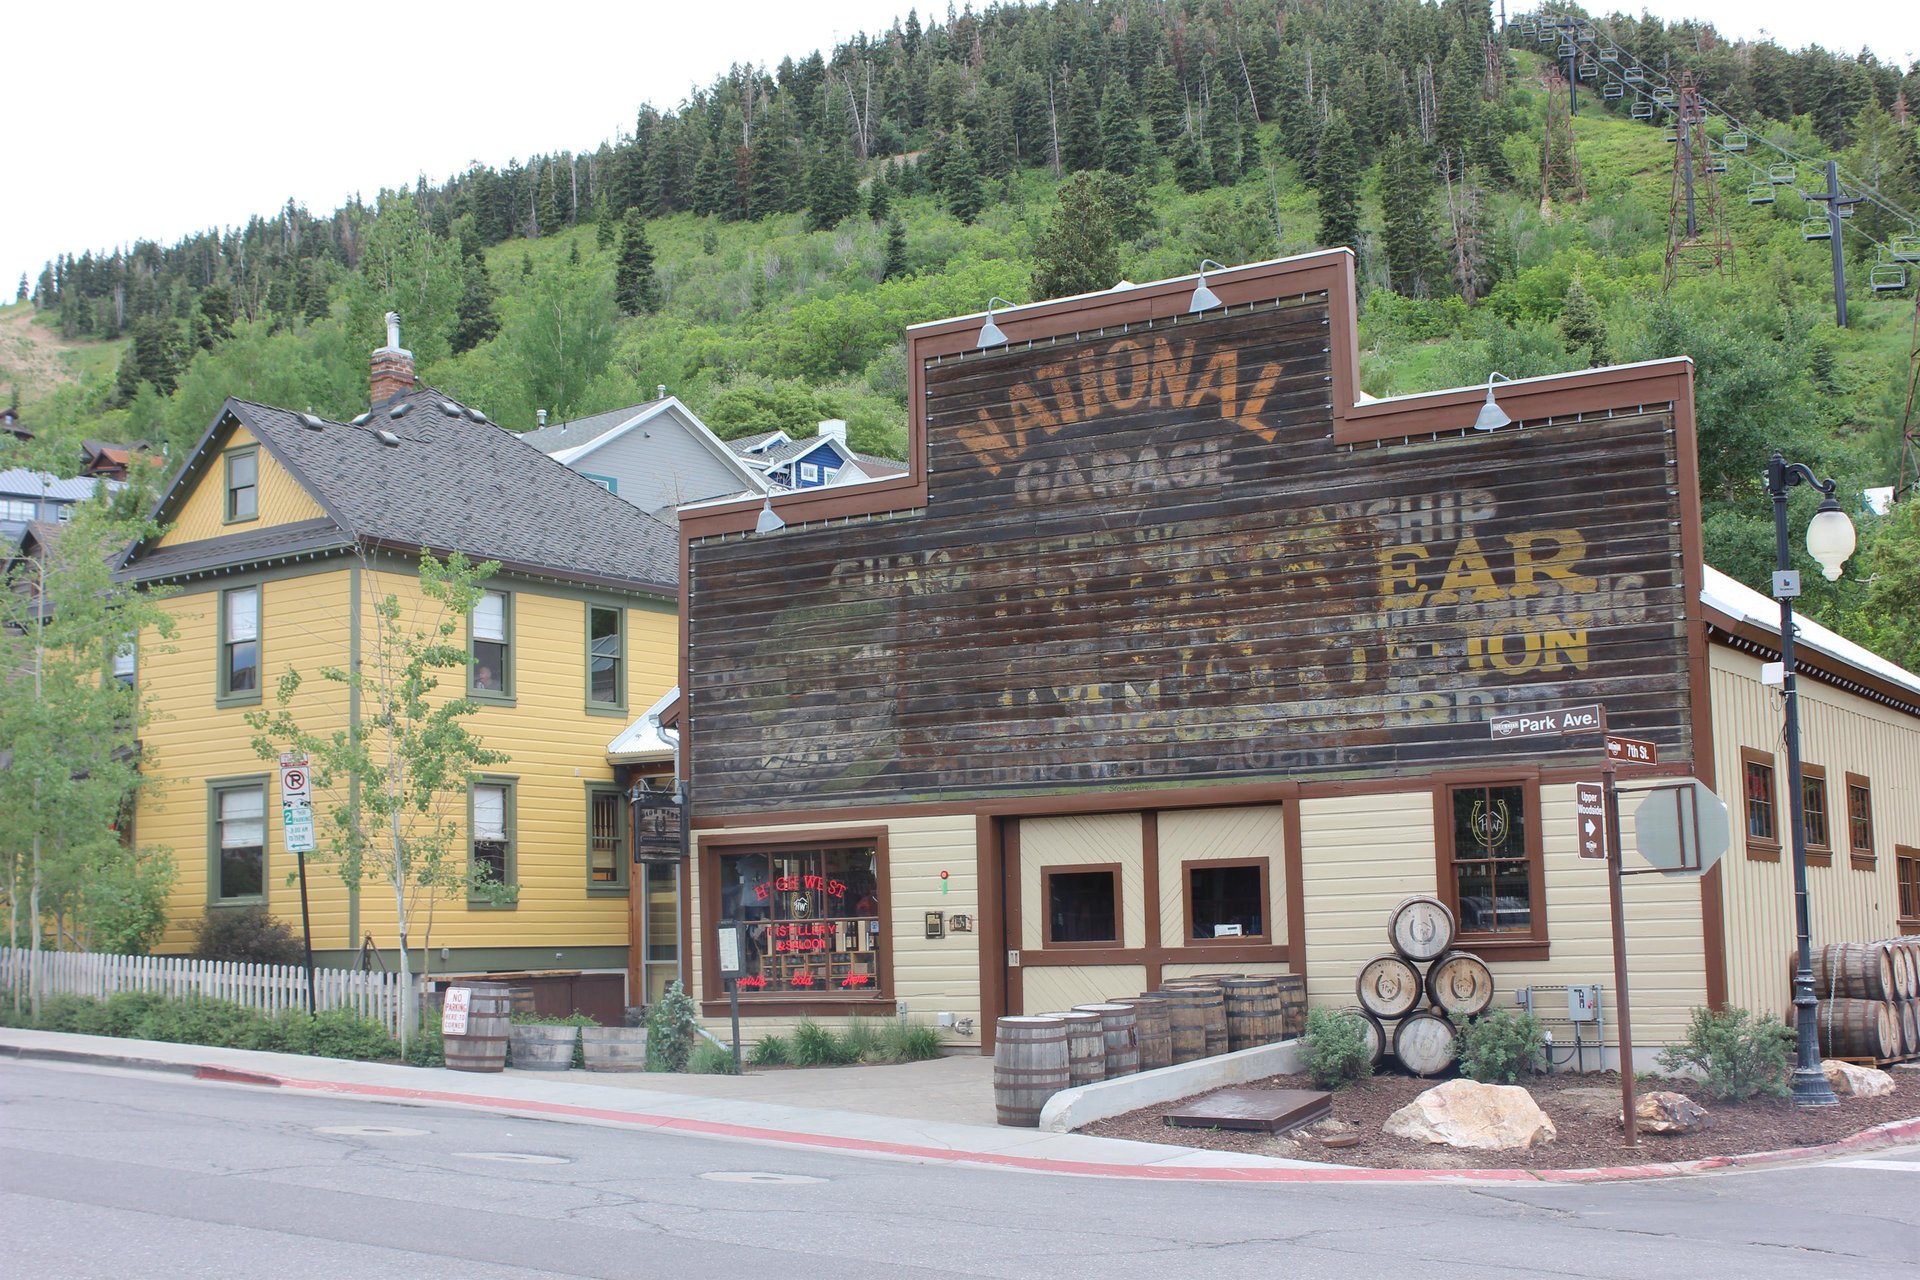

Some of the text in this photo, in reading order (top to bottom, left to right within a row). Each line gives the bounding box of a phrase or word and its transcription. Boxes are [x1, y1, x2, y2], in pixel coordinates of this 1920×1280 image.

[954, 337, 1284, 476] NATIONAL
[1013, 437, 1234, 501] GARAGE
[1519, 715, 1557, 733] Park
[1562, 712, 1598, 728] Ave.
[1626, 743, 1639, 758] 7th
[1639, 746, 1650, 760] St.
[1581, 791, 1598, 803] Upper
[284, 811, 292, 823] 2
[1577, 804, 1603, 816] Woodside
[803, 875, 848, 898] WEST
[736, 970, 868, 989] pirits Sold Here
[452, 993, 462, 1002] NO
[445, 1003, 467, 1013] PARKING
[444, 1021, 464, 1029] CORNER
